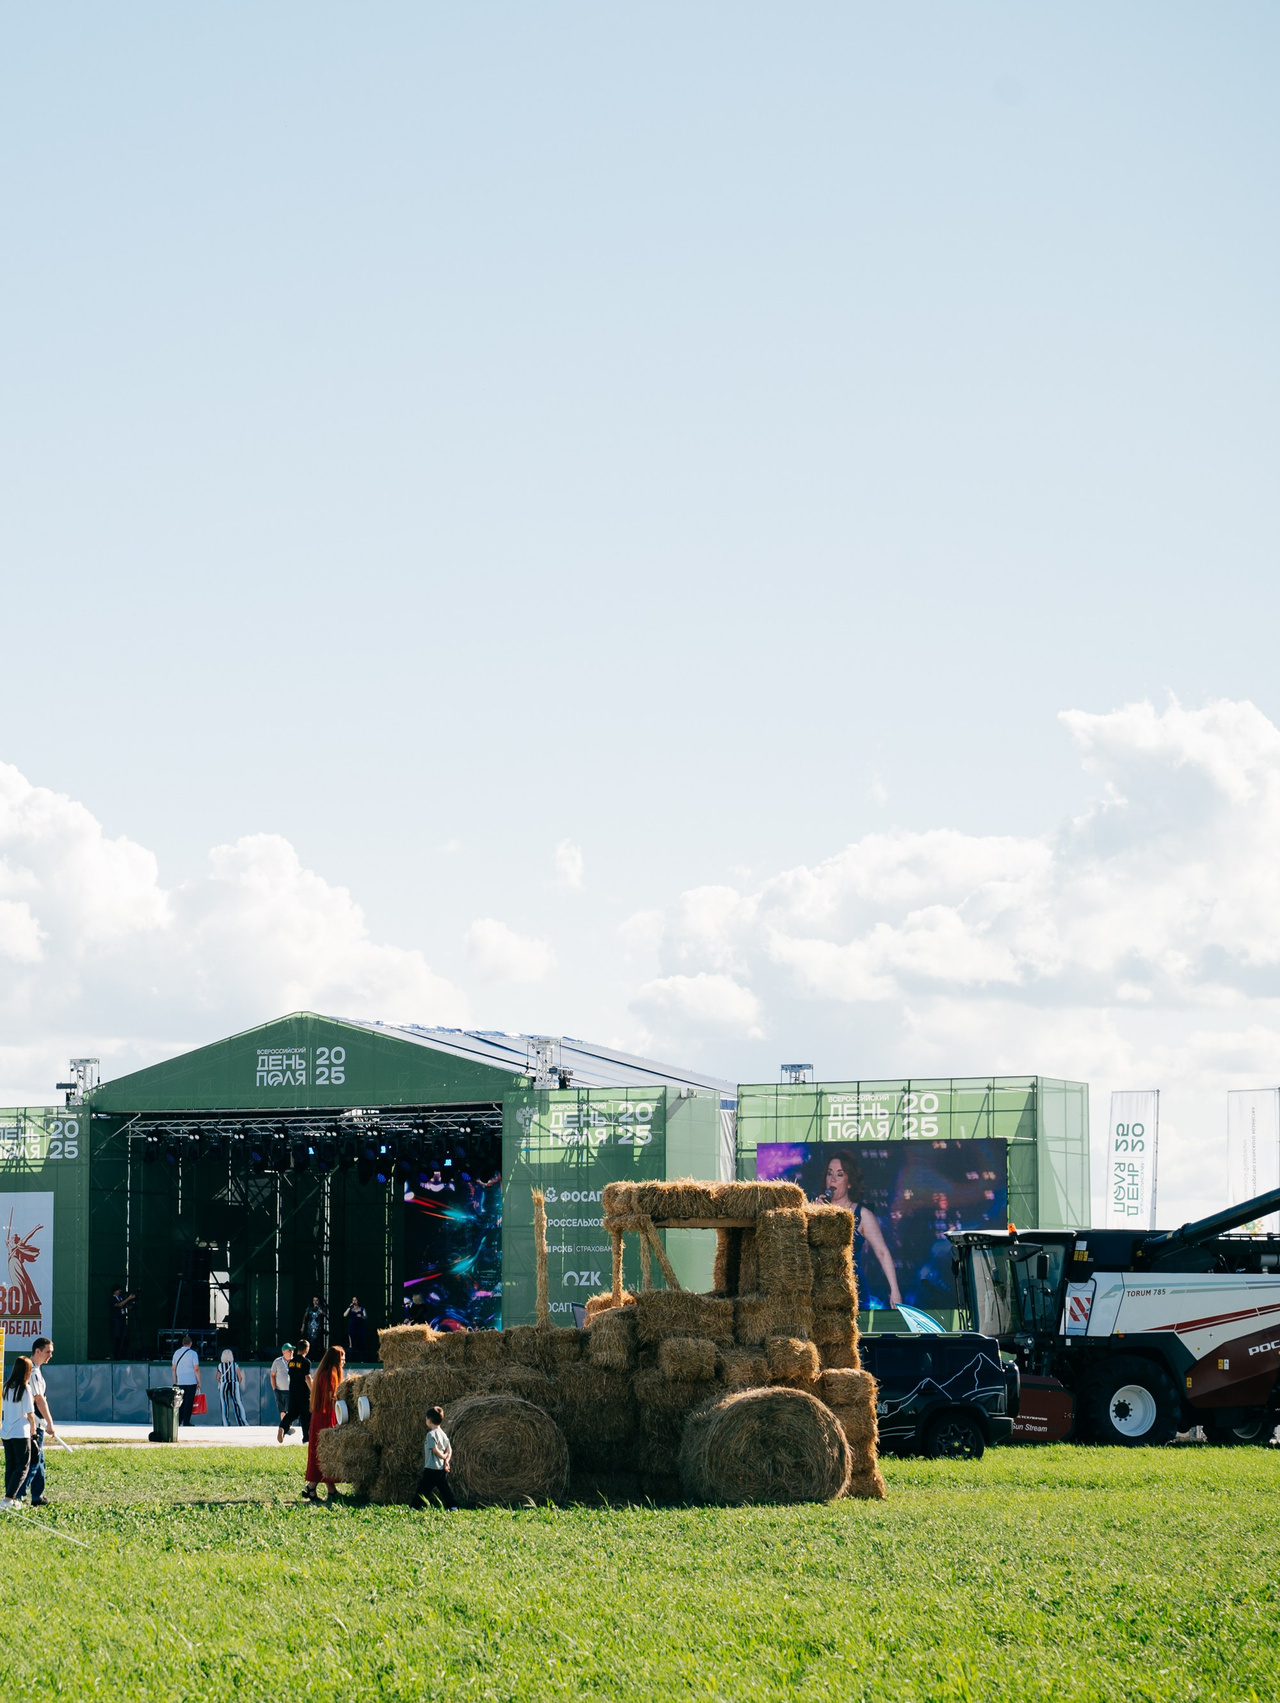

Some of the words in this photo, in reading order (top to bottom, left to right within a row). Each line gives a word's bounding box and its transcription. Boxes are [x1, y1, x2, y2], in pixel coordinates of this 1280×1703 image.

[256, 1054, 306, 1071] ДЕНЬ
[315, 1046, 346, 1065] 20
[256, 1070, 306, 1087] ПОЛЯ
[315, 1066, 346, 1085] 25
[549, 1111, 608, 1128] ДЕНЬ
[618, 1102, 653, 1123] 20
[827, 1102, 890, 1121] ДЕНЬ
[902, 1093, 939, 1114] 20
[50, 1120, 80, 1139] 20
[549, 1128, 607, 1146] ПОЛЯ
[618, 1124, 653, 1145] 25
[827, 1120, 890, 1139] ПОЛЯ
[902, 1116, 939, 1138] 25
[49, 1141, 79, 1159] 25
[560, 1190, 604, 1202] ФОСАГ
[548, 1218, 604, 1227] РОССЕЛЬХОЗ
[552, 1245, 573, 1253] РСХБ
[575, 1245, 613, 1253] СТРАХОВАН
[1127, 1289, 1151, 1297] TORUM
[1153, 1288, 1166, 1296] 785
[1248, 1340, 1280, 1356] РОС
[1012, 1422, 1024, 1430] Sun
[1025, 1423, 1048, 1432] Stream
